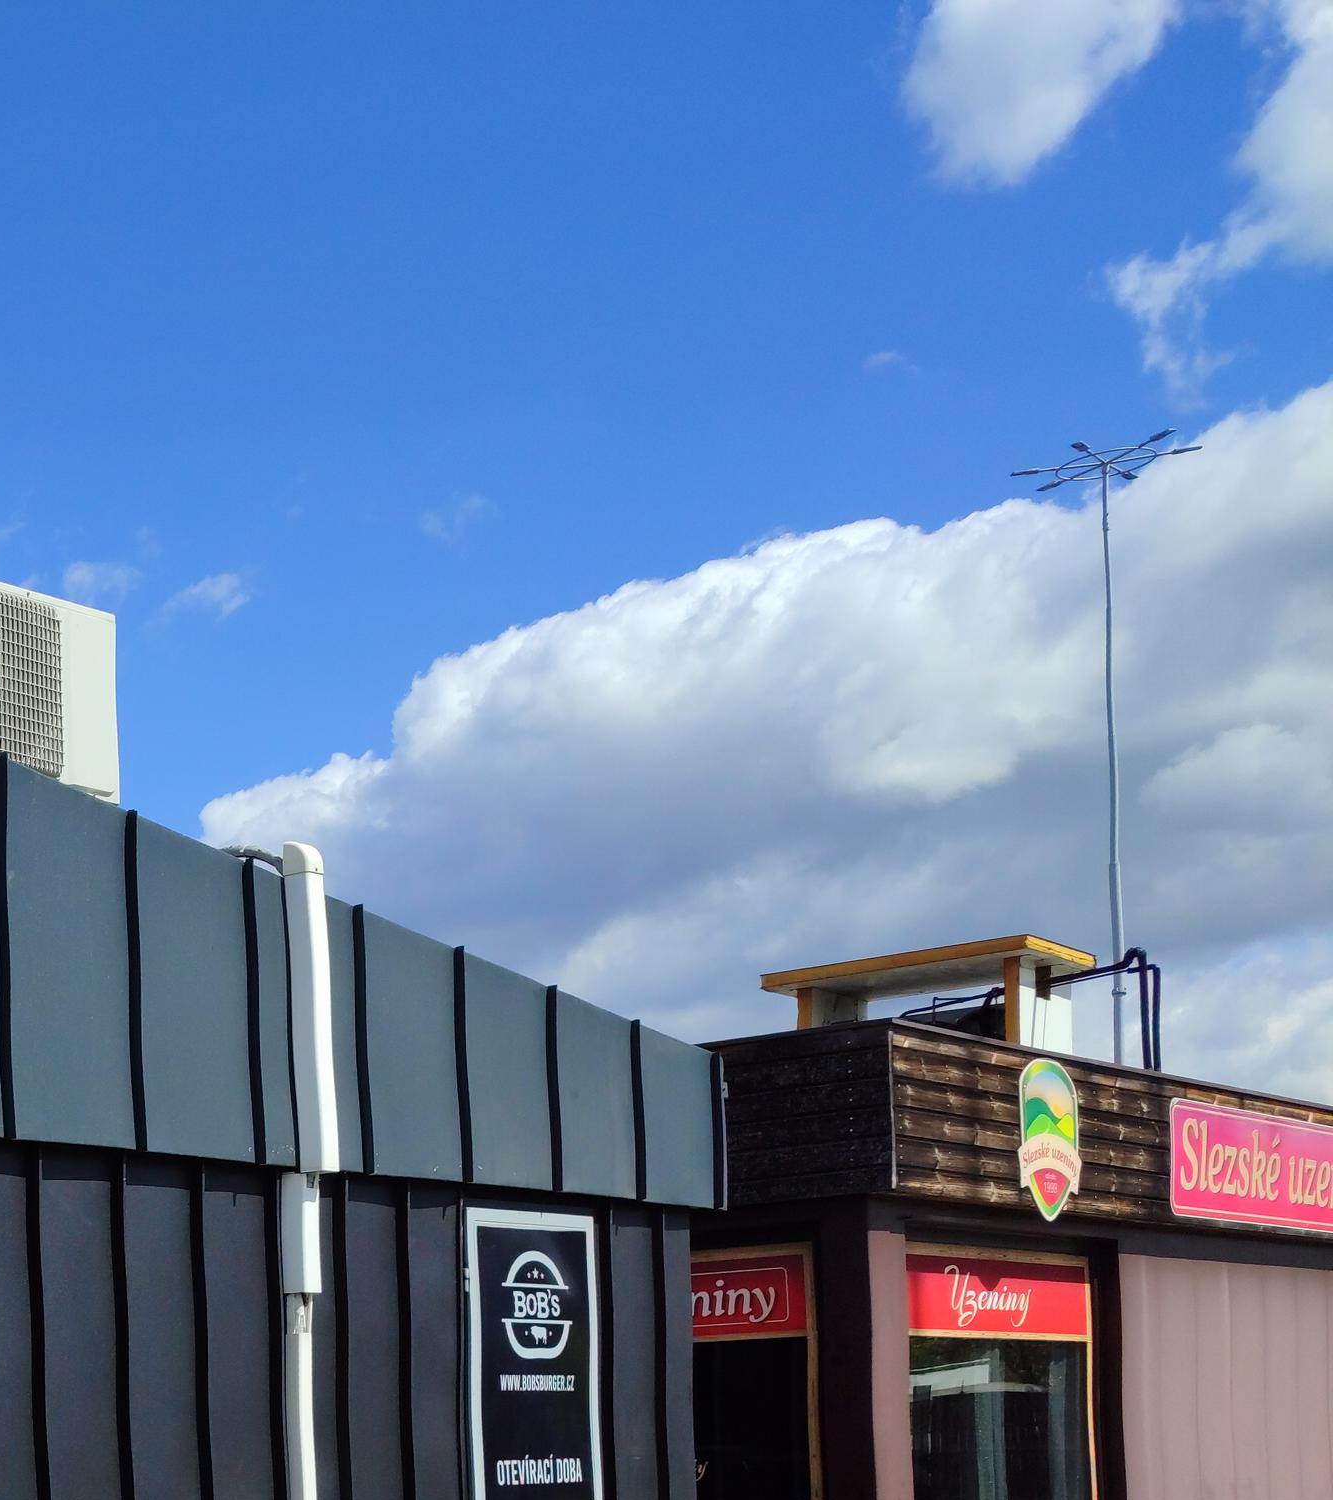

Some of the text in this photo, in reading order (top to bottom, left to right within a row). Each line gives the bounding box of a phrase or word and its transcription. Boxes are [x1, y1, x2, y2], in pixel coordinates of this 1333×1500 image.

[1022, 1142, 1078, 1177] Slezské uzeniny
[1180, 1117, 1333, 1209] Slezské uze
[512, 1289, 561, 1319] BOB'S
[944, 1264, 1033, 1328] Uzeniny
[499, 1374, 575, 1392] WWW.BOBSBURGER.CZ
[496, 1454, 583, 1486] OTEVÍRACÍ DOBA
